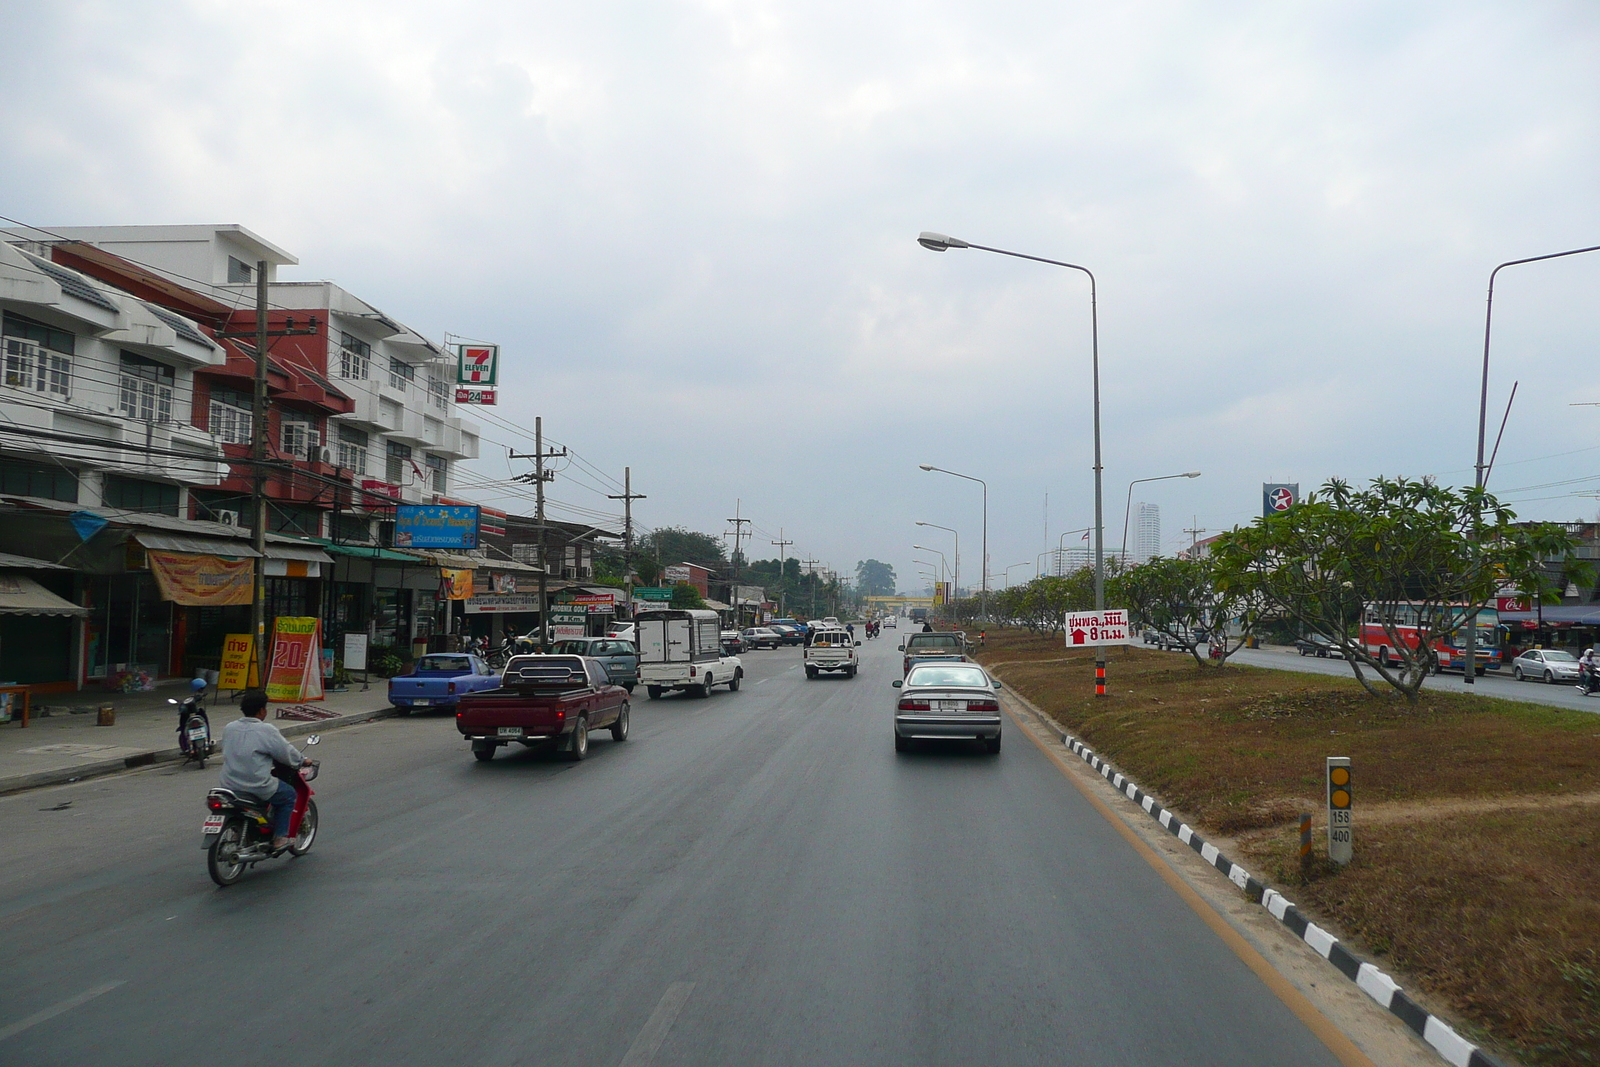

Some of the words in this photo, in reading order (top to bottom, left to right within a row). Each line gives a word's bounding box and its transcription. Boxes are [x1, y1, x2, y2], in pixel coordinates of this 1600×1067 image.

[466, 349, 490, 382] 7
[469, 392, 481, 402] 24
[574, 605, 587, 613] GOLF
[1090, 627, 1098, 641] 8
[227, 638, 248, 653] ถ่าย
[1333, 811, 1350, 823] 158
[1332, 831, 1350, 843] 400
